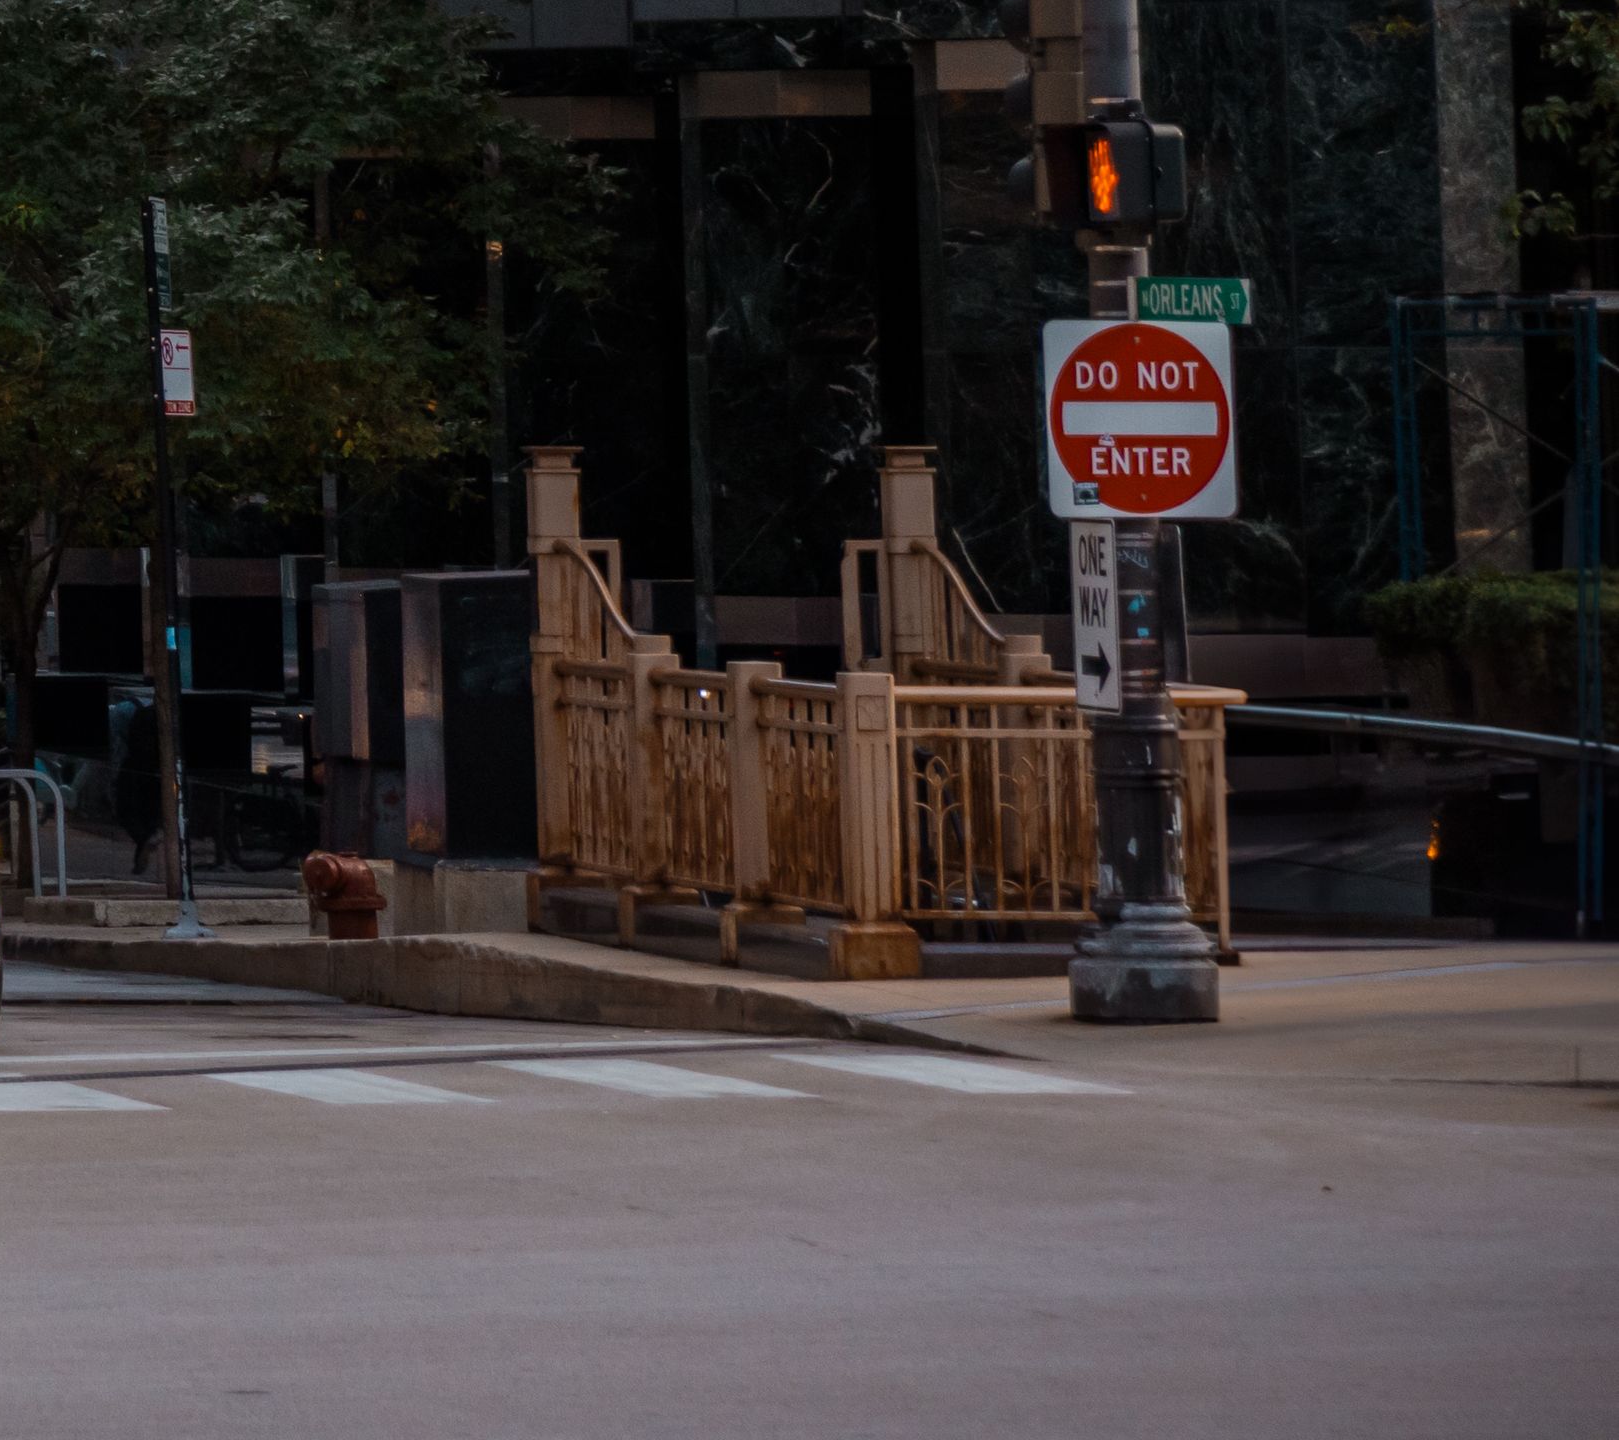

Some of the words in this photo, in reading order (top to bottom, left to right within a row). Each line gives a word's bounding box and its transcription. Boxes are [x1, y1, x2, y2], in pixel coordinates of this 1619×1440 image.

[1149, 283, 1225, 316] ORLEANS
[1229, 292, 1241, 310] ST
[1075, 361, 1118, 390] DO
[1137, 361, 1200, 390] NOT
[1091, 447, 1191, 476] ENTER
[1078, 535, 1107, 577] ONE
[1079, 586, 1108, 628] WAY
